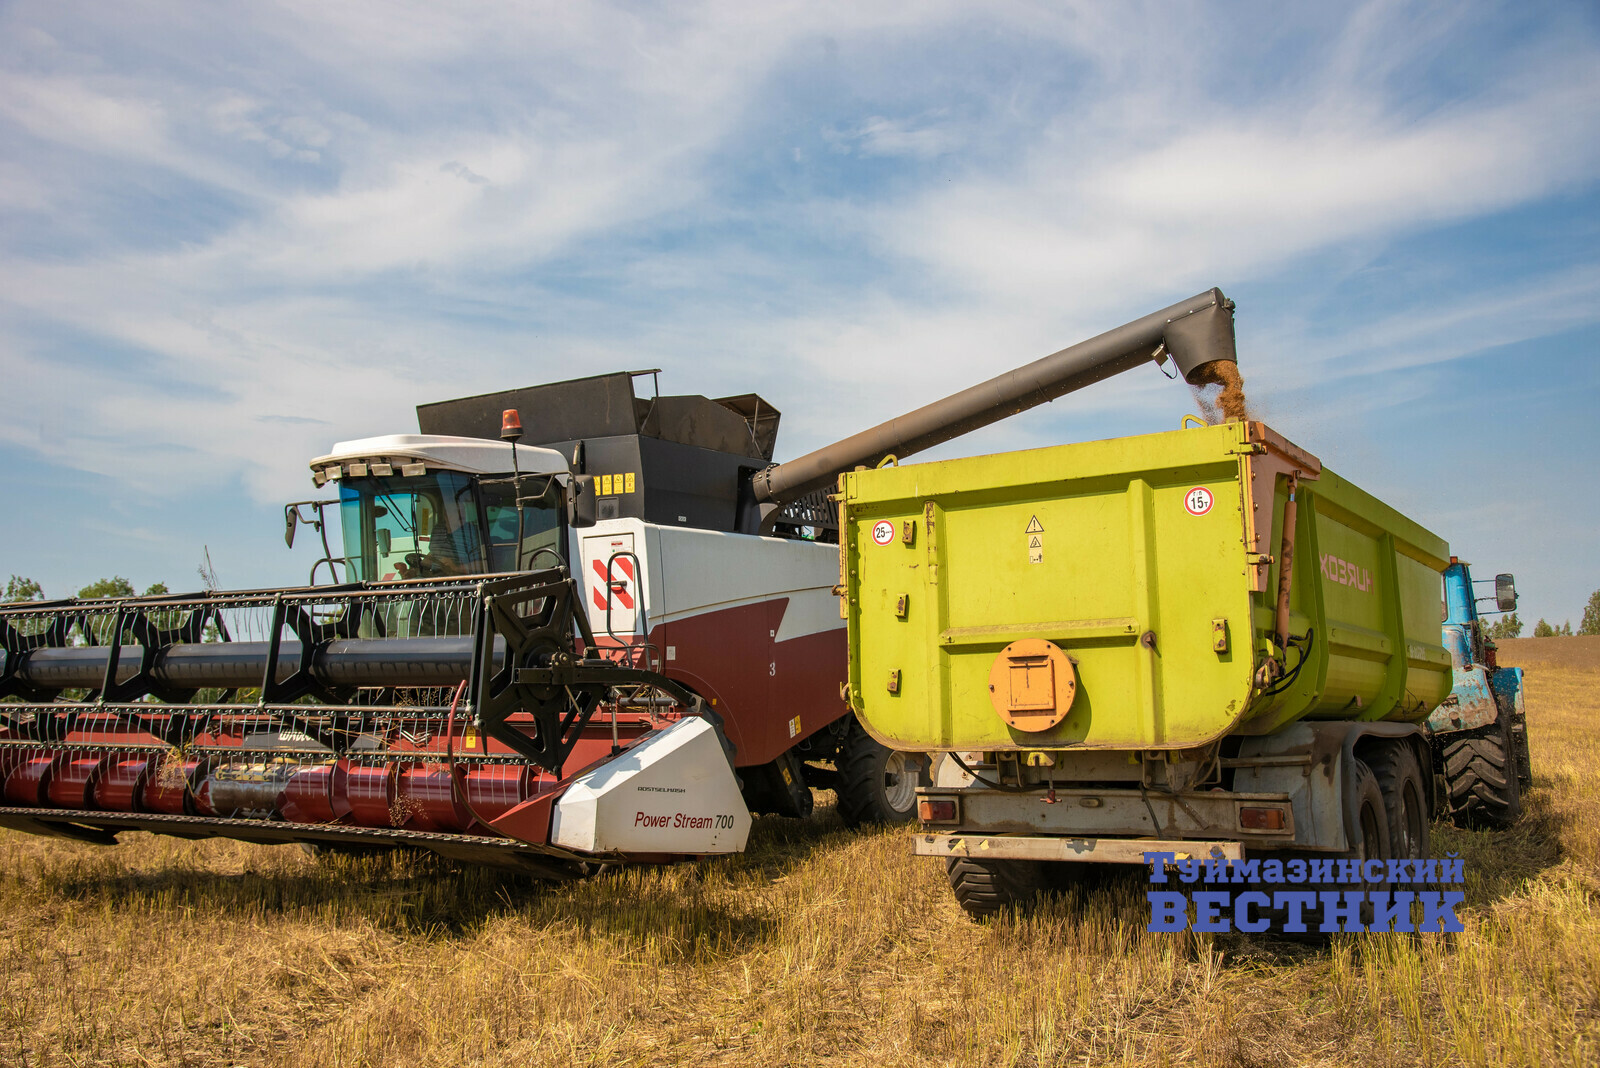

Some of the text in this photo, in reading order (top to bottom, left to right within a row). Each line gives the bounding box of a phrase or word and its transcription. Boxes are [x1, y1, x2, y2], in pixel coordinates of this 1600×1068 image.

[769, 662, 776, 676] 3
[634, 811, 734, 829] Power Stream 700
